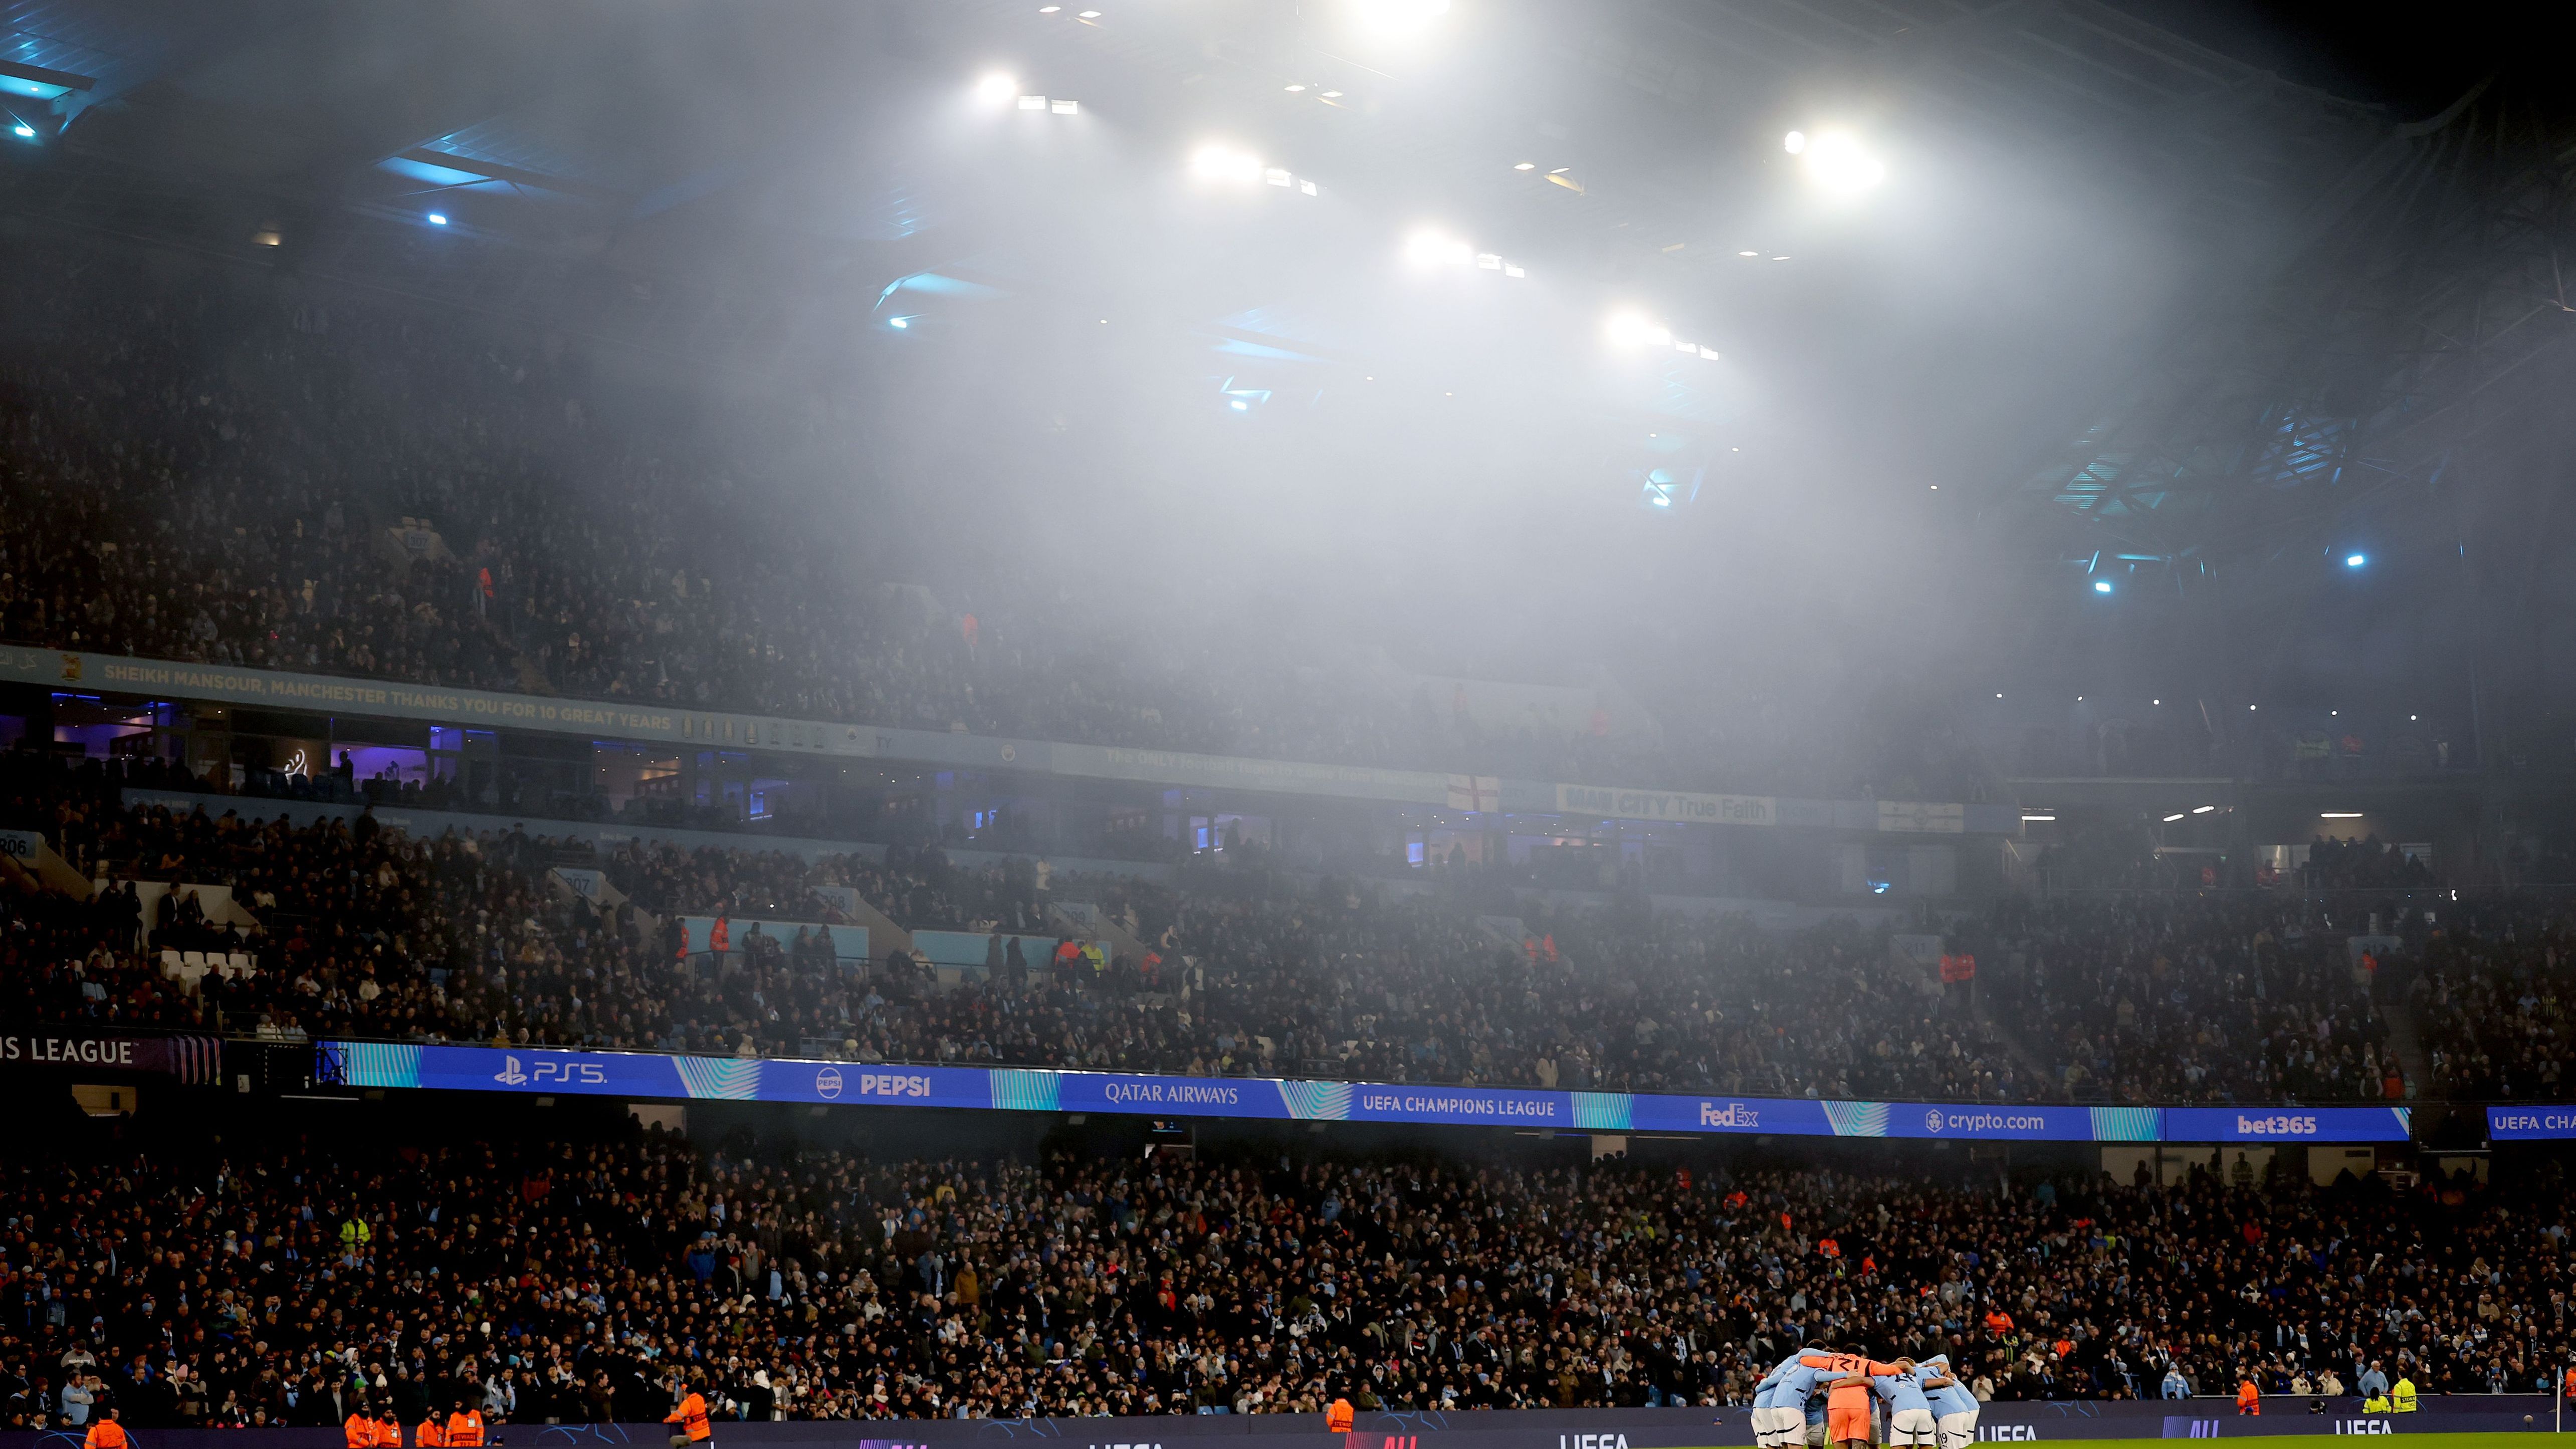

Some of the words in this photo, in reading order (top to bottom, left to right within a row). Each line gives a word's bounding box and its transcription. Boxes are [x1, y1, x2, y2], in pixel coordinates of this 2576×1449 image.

[104, 664, 169, 685] SHEIKH
[174, 672, 266, 695] MANSOUR,
[271, 680, 386, 704] MANCHESTER
[391, 691, 459, 711] THANKS
[463, 697, 498, 714] YOU
[502, 702, 535, 718] FOR
[540, 706, 557, 720] 10
[561, 708, 614, 726] GREAT
[619, 713, 672, 730] YEARS
[1138, 752, 1176, 767] ONLY
[1566, 787, 1613, 811] MAN
[1618, 793, 1669, 815] CITY
[1674, 795, 1716, 816] True
[1722, 798, 1767, 819] Faith
[0, 1037, 20, 1059] S
[31, 1039, 133, 1064] LEAGUE
[534, 1062, 604, 1084] PS5
[818, 1079, 841, 1087] PEPSI
[862, 1075, 930, 1097] PEPSI
[1106, 1083, 1163, 1104] QATAR
[1167, 1086, 1238, 1104] AIRWAYS
[1364, 1096, 1401, 1111] UEFA
[1405, 1097, 1494, 1115] CHAMPIONS
[1498, 1100, 1555, 1116] LEAGUE
[1701, 1102, 1759, 1127] FedEx
[1949, 1113, 2044, 1132] crypto.com
[2238, 1116, 2316, 1134] bet365
[2495, 1117, 2539, 1130] UEFA
[1940, 1432, 1948, 1444] 19
